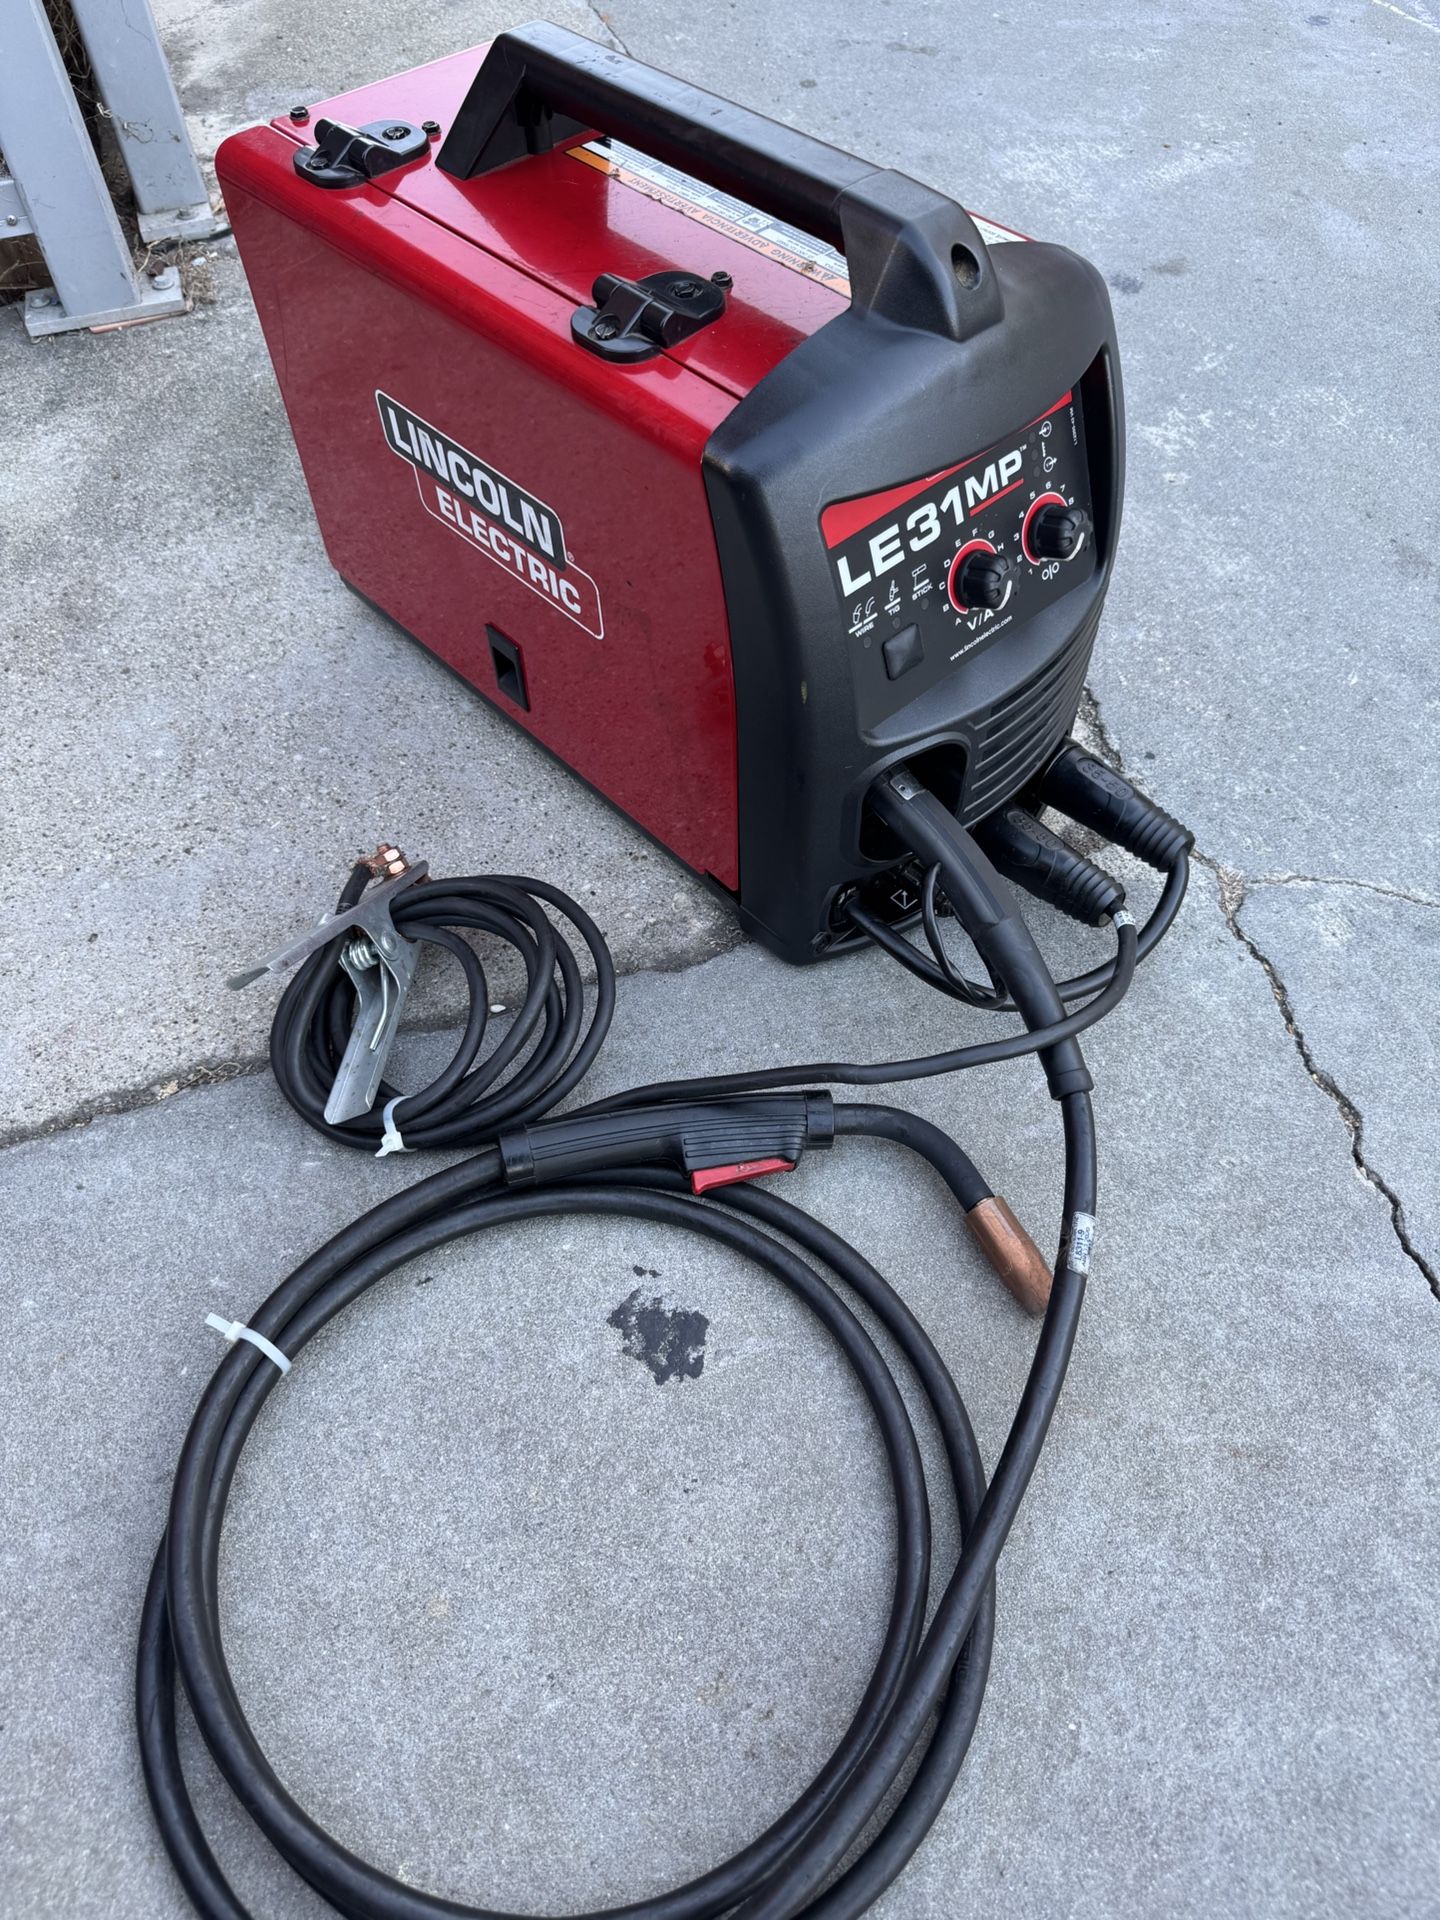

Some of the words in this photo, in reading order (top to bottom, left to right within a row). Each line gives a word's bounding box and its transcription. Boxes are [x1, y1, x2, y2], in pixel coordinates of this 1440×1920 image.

[387, 406, 555, 557] LINCOLN
[1060, 483, 1066, 493] 7
[971, 527, 978, 537] F
[955, 538, 962, 548] E
[997, 542, 1004, 551] H
[435, 485, 582, 615] ELECTRIC
[943, 558, 951, 568] D
[938, 581, 946, 591] C
[911, 582, 933, 601] STICK
[887, 604, 900, 616] TIG
[942, 603, 950, 613] B
[955, 617, 962, 626] A
[967, 608, 994, 631] V/A
[854, 622, 875, 638] WIRE
[950, 615, 1013, 661] www.lincolnelectric.com
